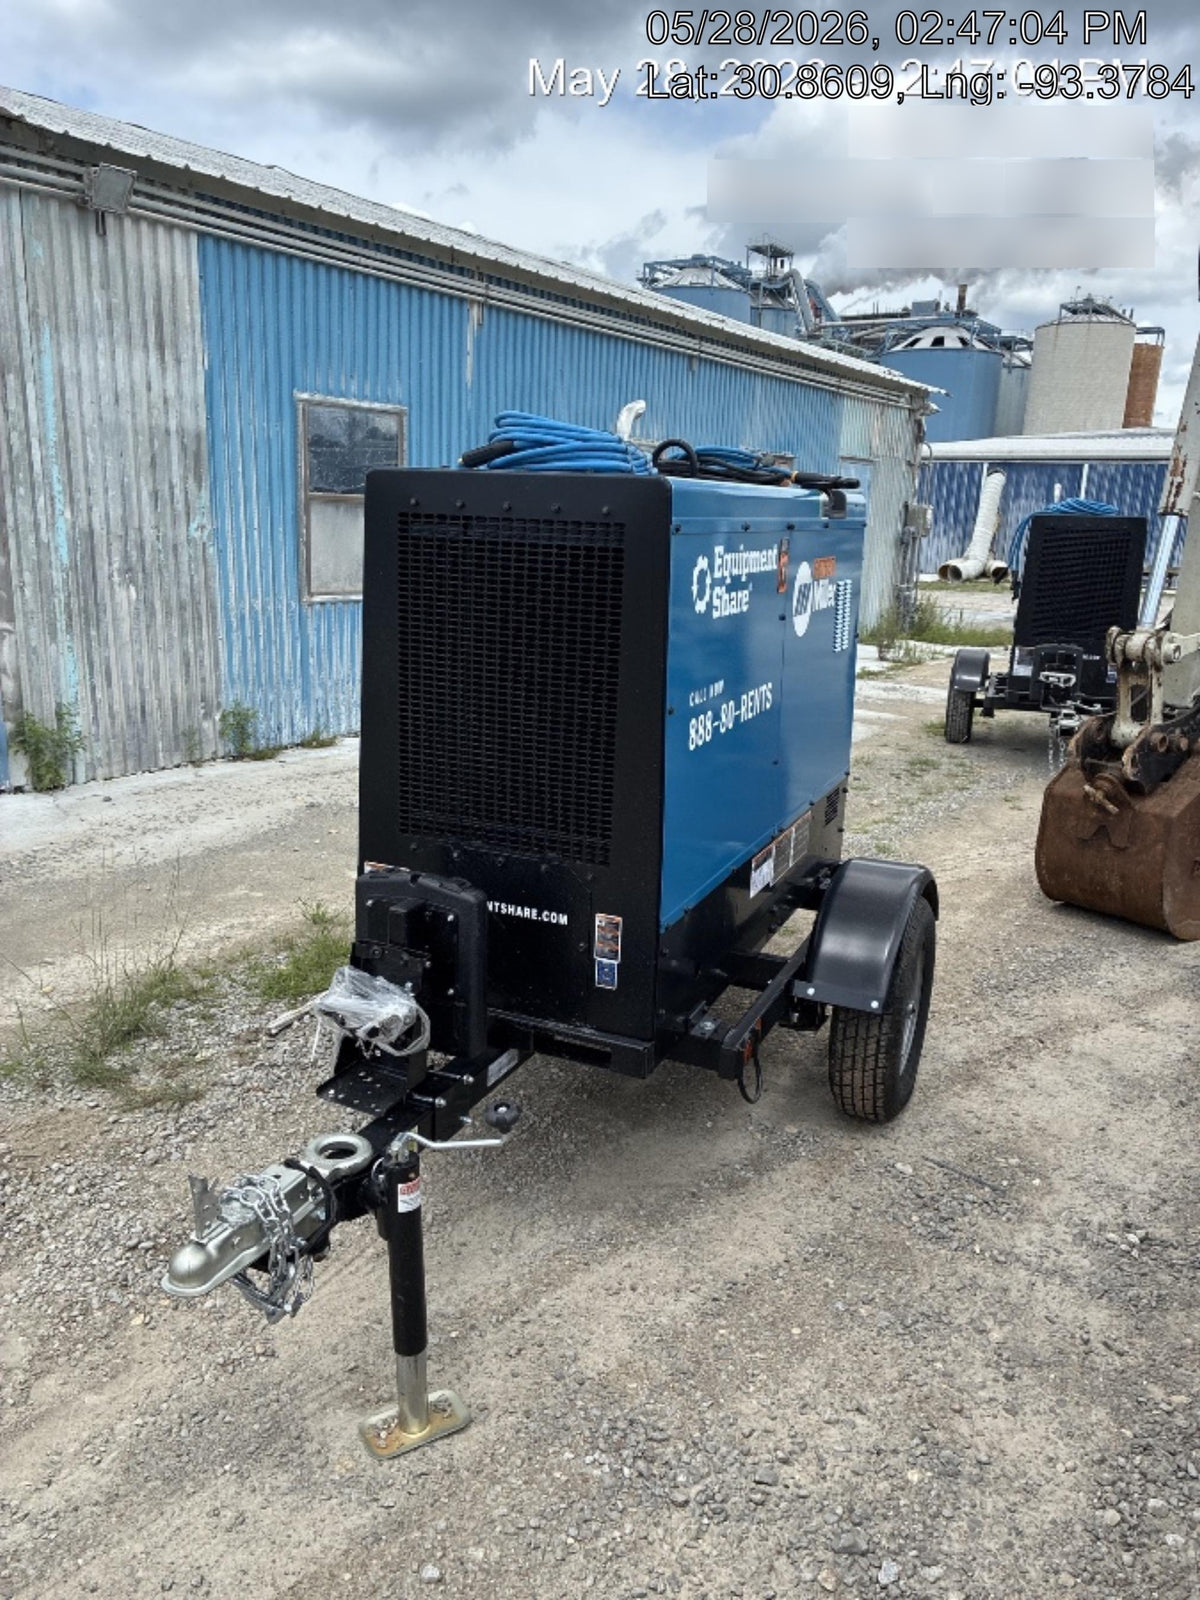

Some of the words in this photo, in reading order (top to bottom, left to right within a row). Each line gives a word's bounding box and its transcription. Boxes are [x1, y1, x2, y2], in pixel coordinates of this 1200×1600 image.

[713, 543, 779, 584] Equipment
[711, 585, 750, 620] Share
[688, 681, 773, 752] 888-80-RENTS
